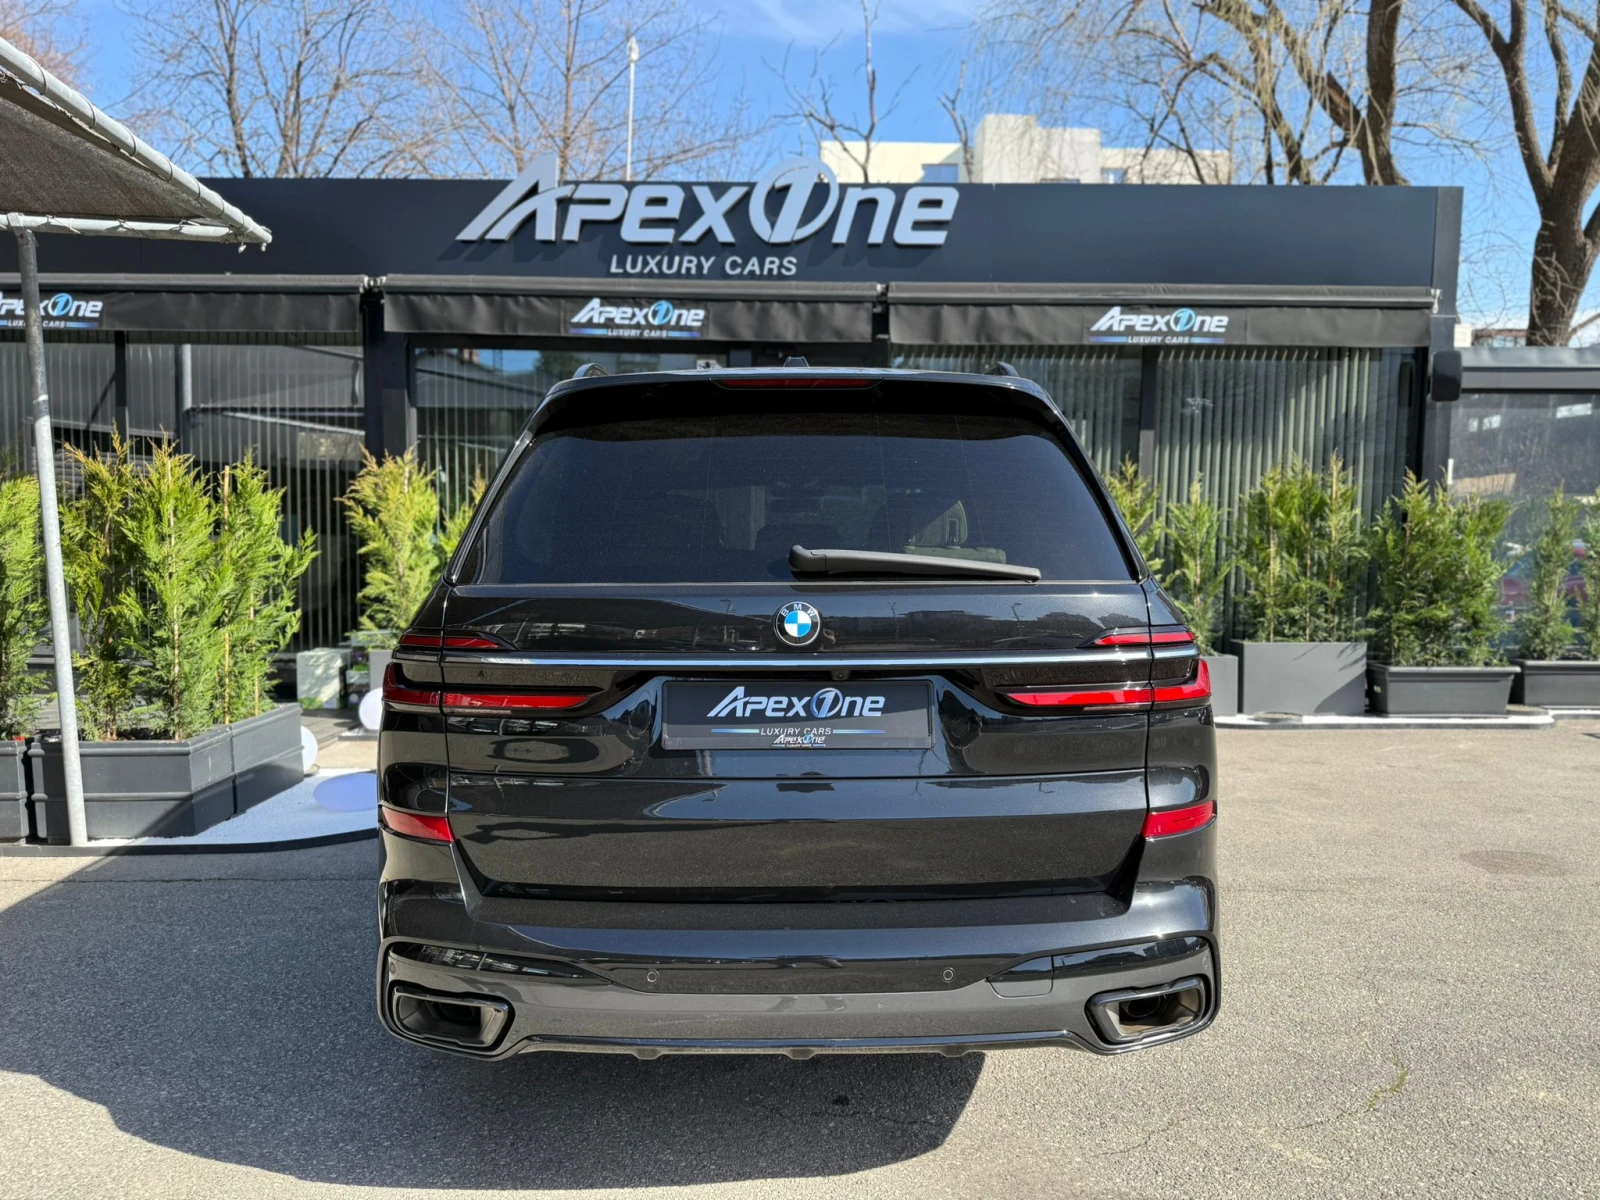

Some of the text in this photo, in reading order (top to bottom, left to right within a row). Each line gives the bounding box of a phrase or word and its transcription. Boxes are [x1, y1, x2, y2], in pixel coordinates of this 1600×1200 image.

[609, 254, 798, 276] LUXURY CARS
[42, 320, 66, 328] CARS
[608, 328, 668, 338] LUXURY CARS
[1128, 335, 1190, 344] LUXURY CARS
[779, 603, 817, 617] BMW
[760, 727, 832, 736] LUXURY CARS
